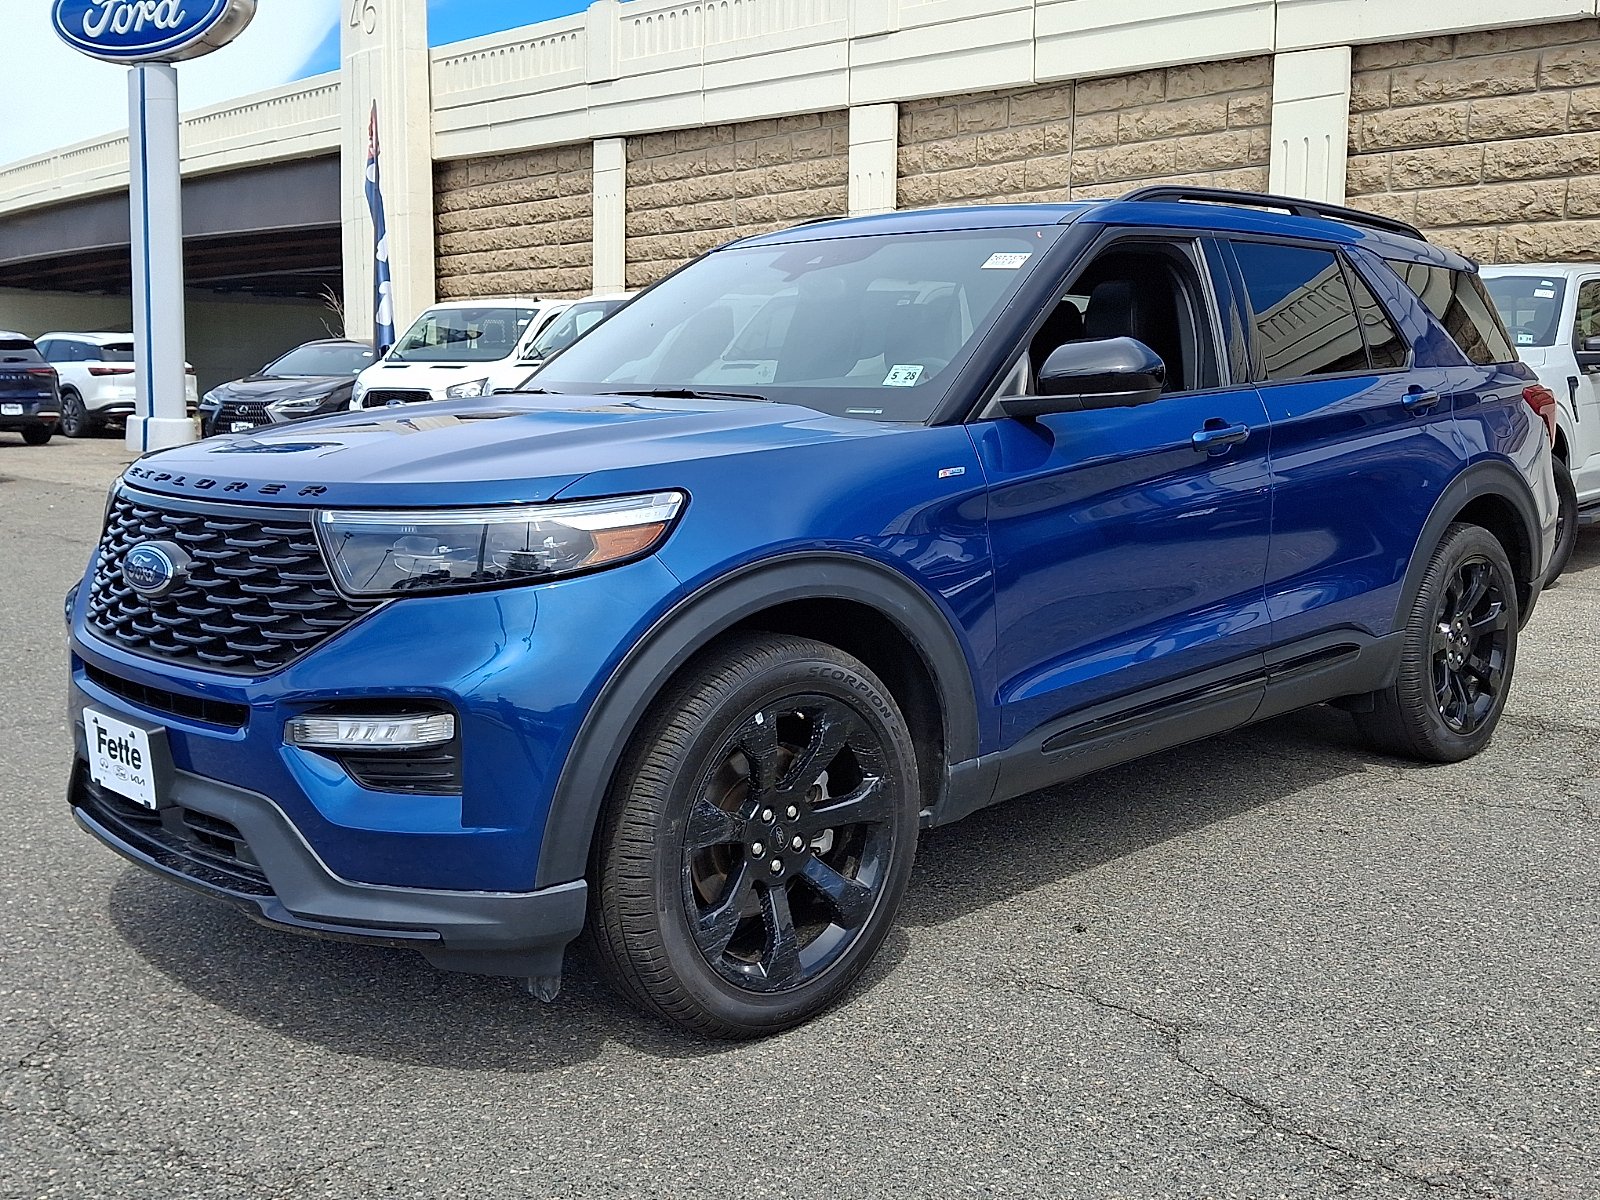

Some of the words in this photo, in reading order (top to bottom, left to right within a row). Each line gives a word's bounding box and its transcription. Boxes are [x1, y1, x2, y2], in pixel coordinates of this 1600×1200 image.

[82, 0, 186, 38] Ford
[890, 371, 900, 380] 5
[903, 371, 917, 380] 28
[128, 466, 328, 497] EXPLORER
[127, 554, 155, 583] Ford
[806, 666, 892, 719] SCORPION
[96, 725, 142, 770] Fette
